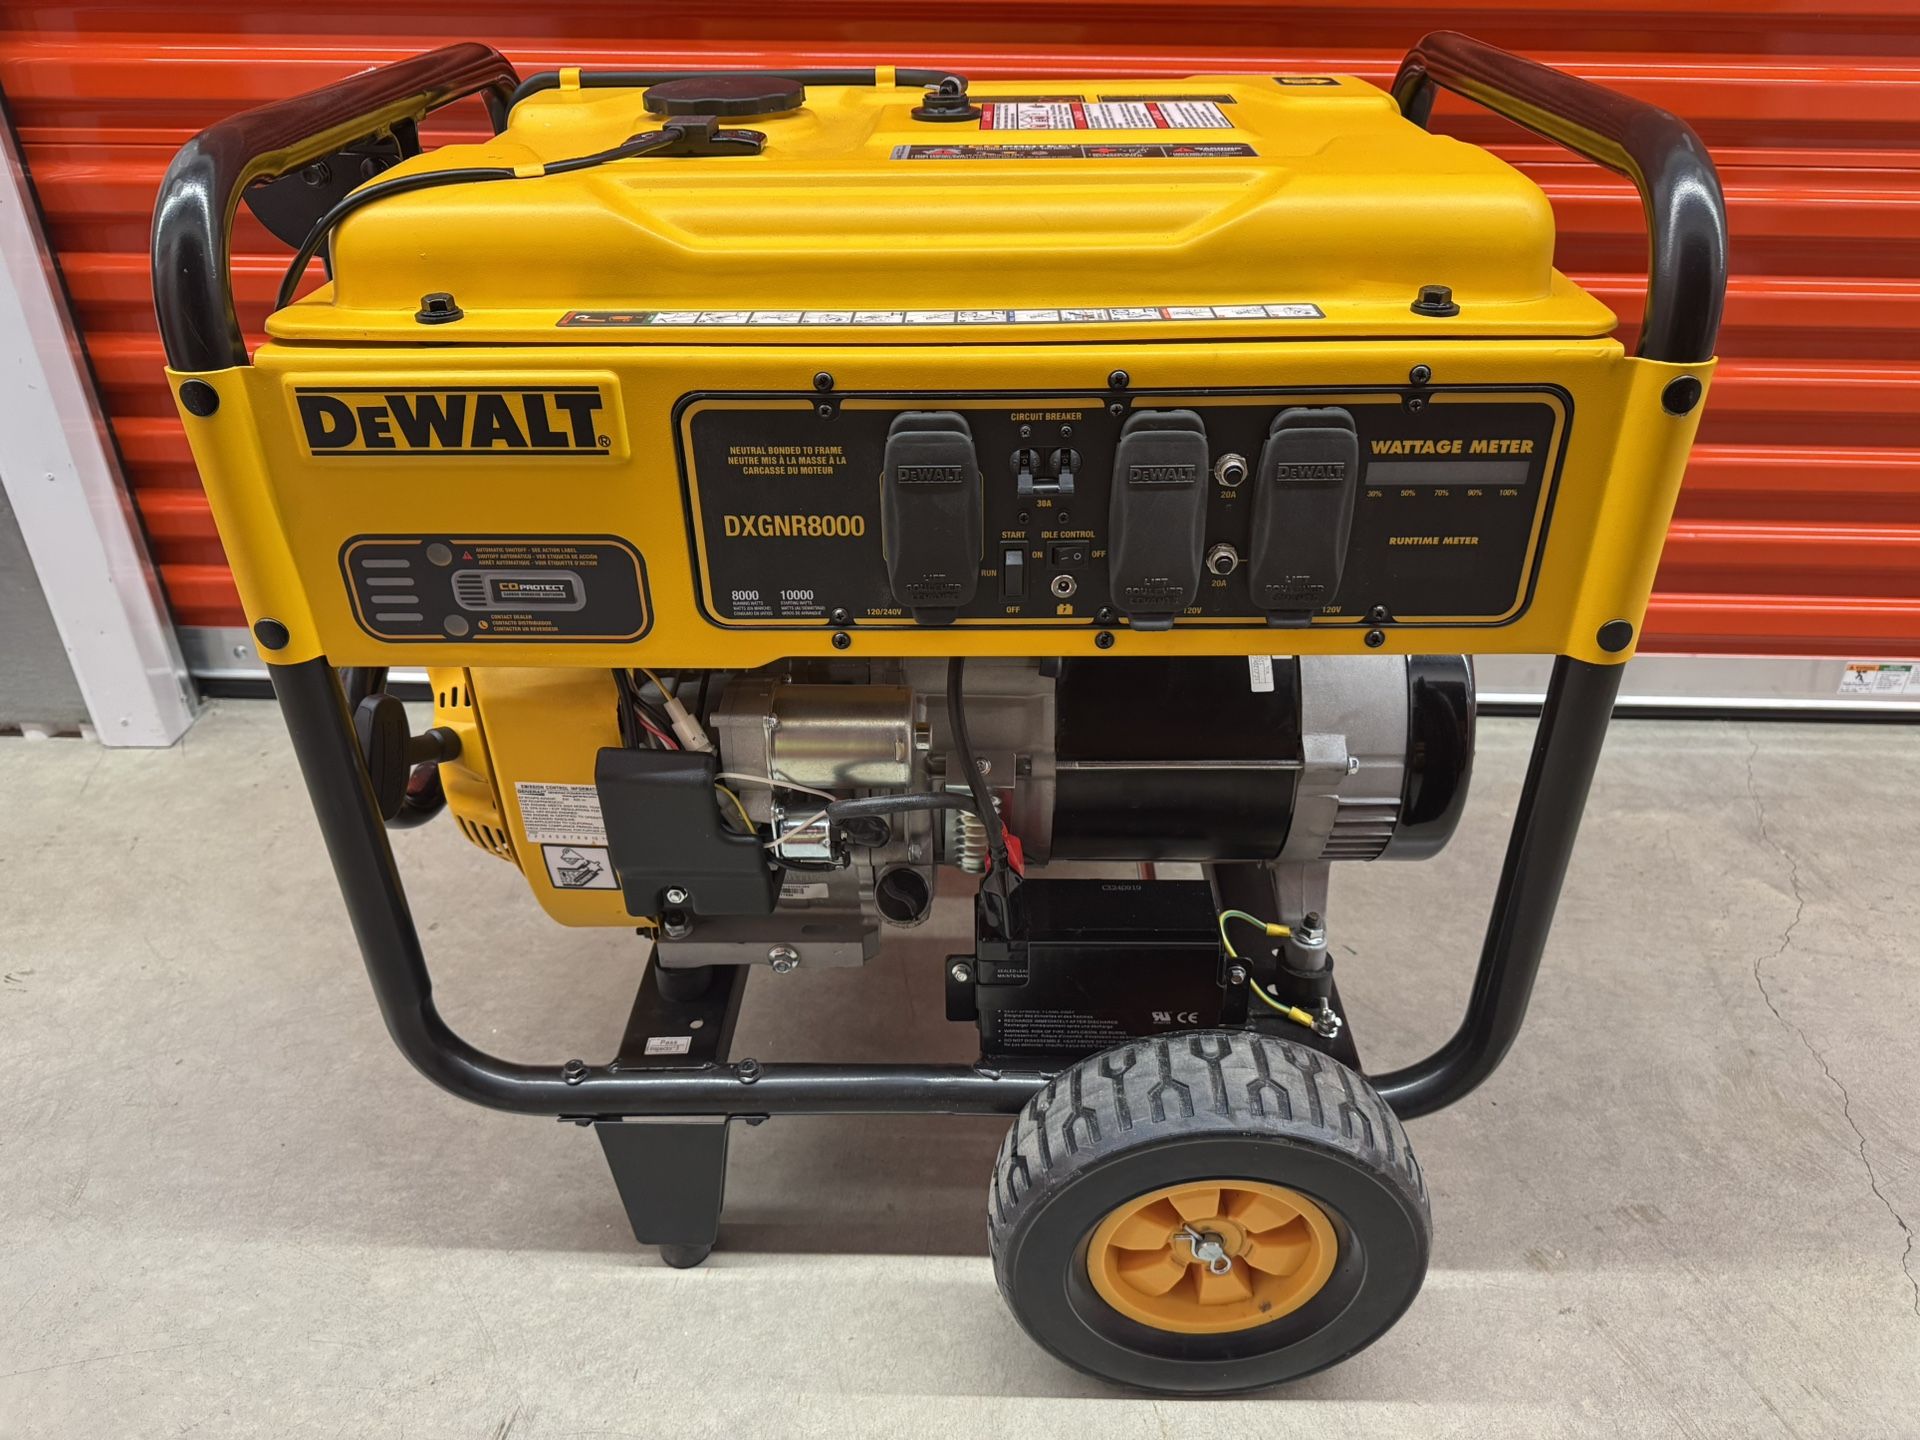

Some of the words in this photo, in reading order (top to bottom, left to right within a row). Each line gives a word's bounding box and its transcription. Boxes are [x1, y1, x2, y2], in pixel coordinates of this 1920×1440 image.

[1011, 412, 1043, 421] CIRCUIT
[1045, 412, 1082, 421] BREAKER
[730, 446, 767, 455] NEUTRAL
[768, 446, 801, 455] BONDED
[803, 446, 813, 455] TO
[815, 446, 843, 455] FRAME
[1371, 440, 1462, 454] WATTAGE
[1469, 440, 1534, 454] METER
[728, 456, 760, 465] NEUTRE
[762, 456, 777, 465] MIS
[779, 455, 785, 465] À
[787, 456, 797, 465] LA
[798, 456, 825, 465] MASSE
[827, 455, 834, 465] À
[836, 456, 847, 465] LA
[743, 466, 785, 475] CARCASSE
[787, 466, 799, 475] DU
[800, 466, 833, 475] MOTEUR
[1220, 491, 1236, 499] 20A
[1367, 489, 1382, 497] 30%
[1400, 489, 1416, 497] 50%
[1434, 489, 1449, 497] 70%
[1467, 489, 1483, 497] 90%
[1499, 489, 1518, 497] 100%
[1037, 500, 1052, 508] 30A
[724, 514, 865, 537] DXGNR8000
[1002, 531, 1026, 539] START
[1041, 530, 1059, 538] IDLE
[1060, 530, 1095, 538] CONTROL
[1389, 537, 1439, 545] RUNTIME
[1443, 537, 1479, 545] METER
[1092, 550, 1106, 558] OFF
[731, 590, 759, 600] 8000
[780, 589, 814, 600] 10000
[866, 608, 902, 616] 120/240V
[1006, 606, 1020, 614] OFF
[1322, 605, 1342, 614] 120V
[1177, 1011, 1199, 1024] CE
